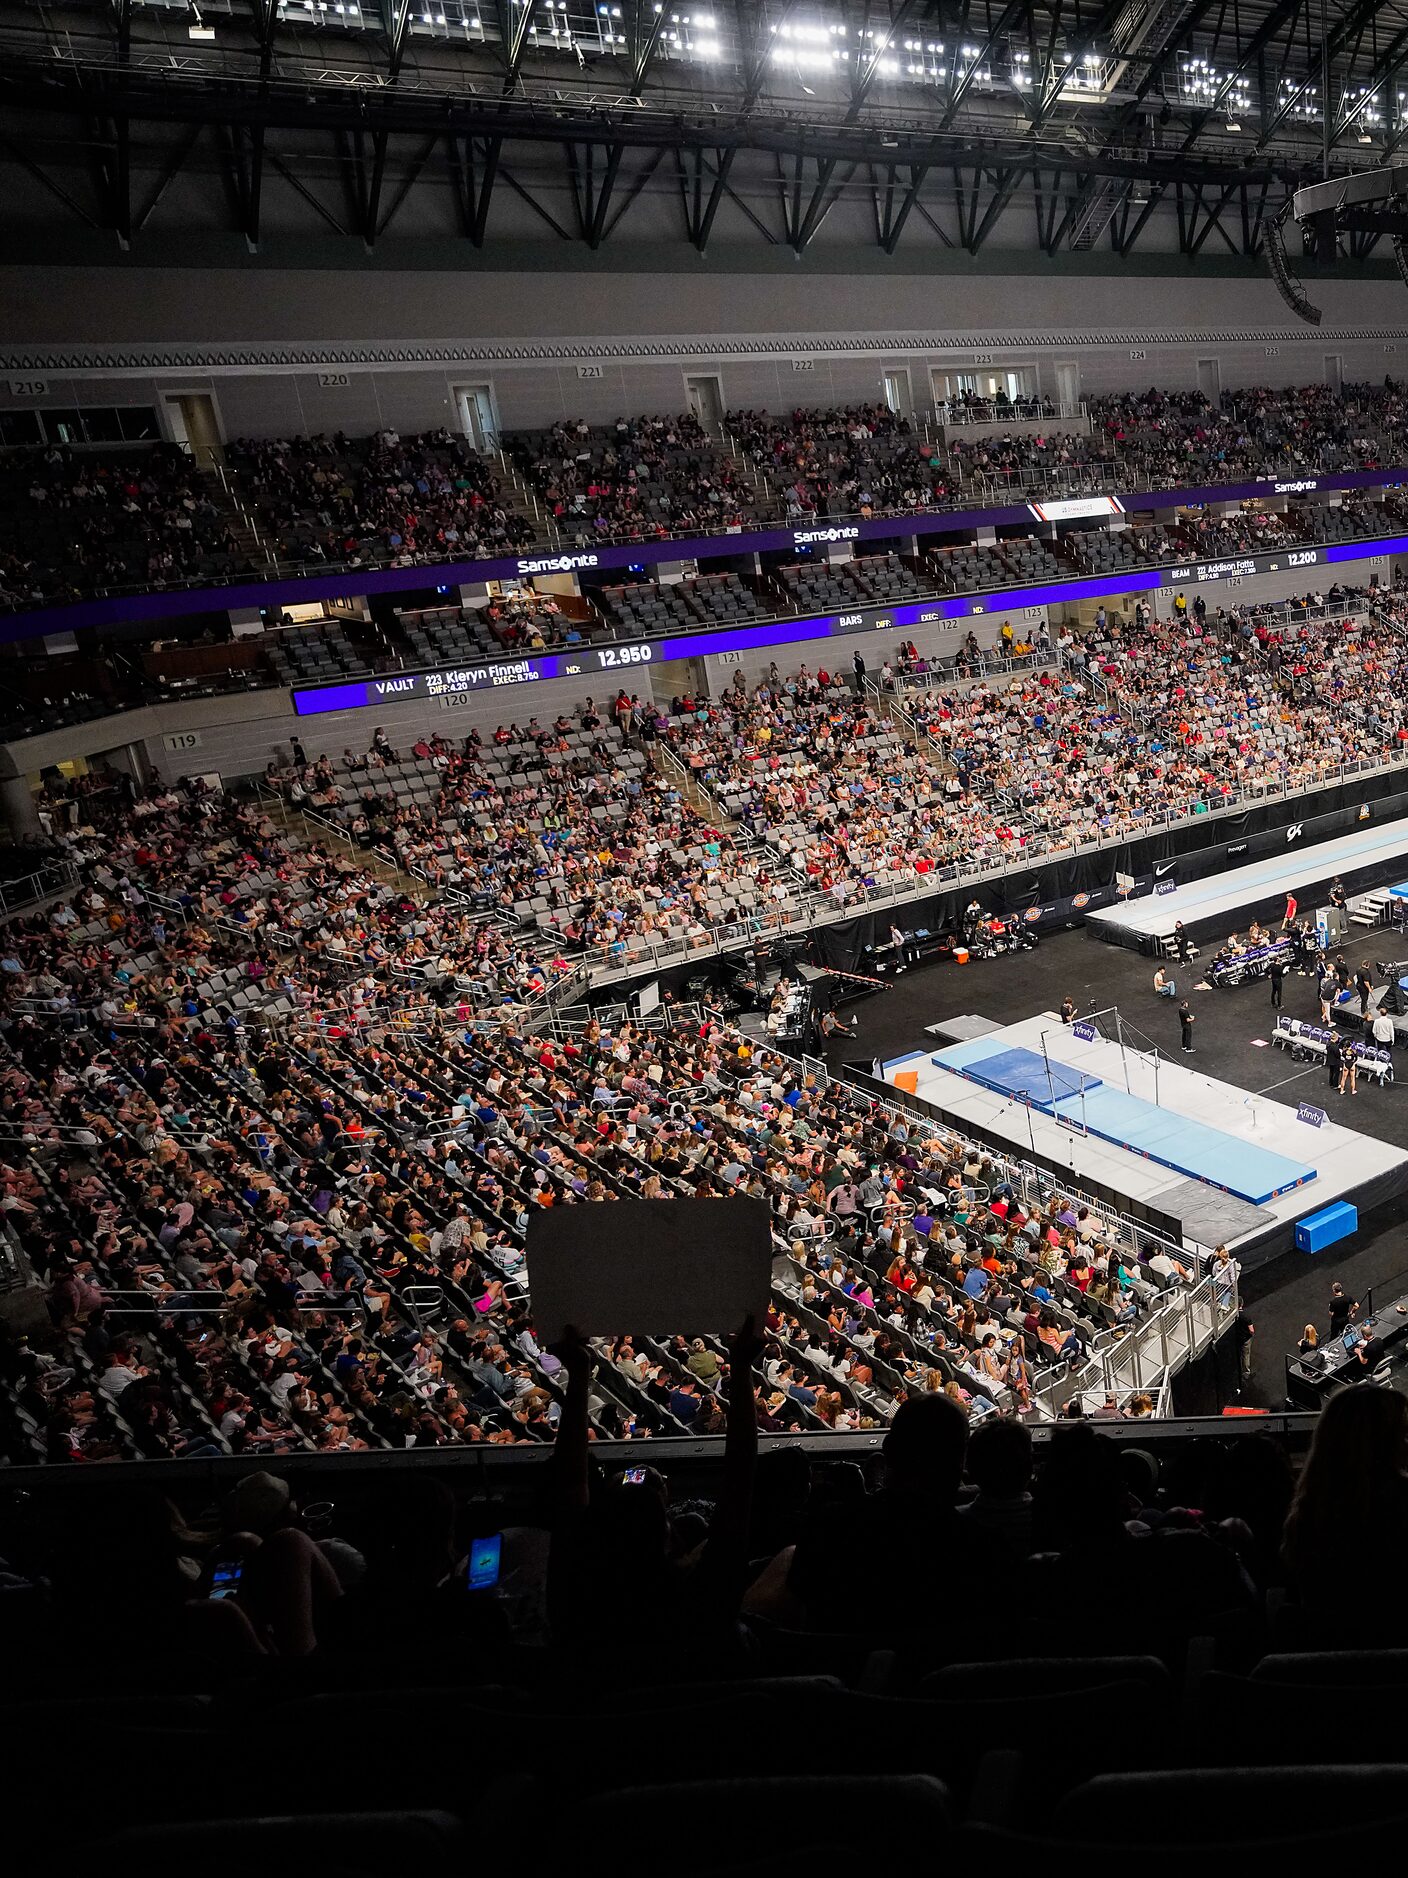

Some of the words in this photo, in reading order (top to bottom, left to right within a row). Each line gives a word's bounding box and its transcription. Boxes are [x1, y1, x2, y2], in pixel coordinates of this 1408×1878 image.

[1131, 351, 1145, 360] 224
[1266, 347, 1279, 356] 225
[794, 360, 813, 370] 222
[976, 355, 991, 364] 223
[581, 367, 600, 377] 221
[322, 374, 347, 386] 220
[15, 381, 45, 394] 219
[1274, 480, 1317, 493] Samsonite
[794, 526, 859, 543] Samsonite
[518, 552, 598, 574] Samsonite
[1172, 568, 1190, 579] BEAM
[1197, 566, 1206, 575] 222
[1208, 563, 1236, 574] Addison
[1237, 560, 1254, 569] Fatta
[1287, 551, 1317, 566] 12.200
[1372, 557, 1383, 565] 125
[1229, 578, 1241, 587] 124
[1160, 588, 1173, 597] 123
[921, 613, 939, 622] EXEC:
[1026, 607, 1042, 617] 123
[839, 614, 862, 627] BARS
[942, 620, 958, 630] 122
[723, 652, 741, 663] 121
[376, 678, 415, 694] VAULT
[426, 675, 443, 687] 223
[445, 668, 487, 687] Kieryn
[489, 661, 530, 678] Finnell
[598, 645, 652, 668] 12.950
[429, 682, 468, 695] DIFF:4.20
[493, 671, 539, 686] EXEC:8.750
[566, 665, 581, 675] ND:
[443, 693, 468, 707] 120
[171, 734, 196, 749] 119
[1157, 882, 1175, 894] xfinity
[1075, 1025, 1095, 1039] xfinity
[1298, 1108, 1322, 1123] xfinity
